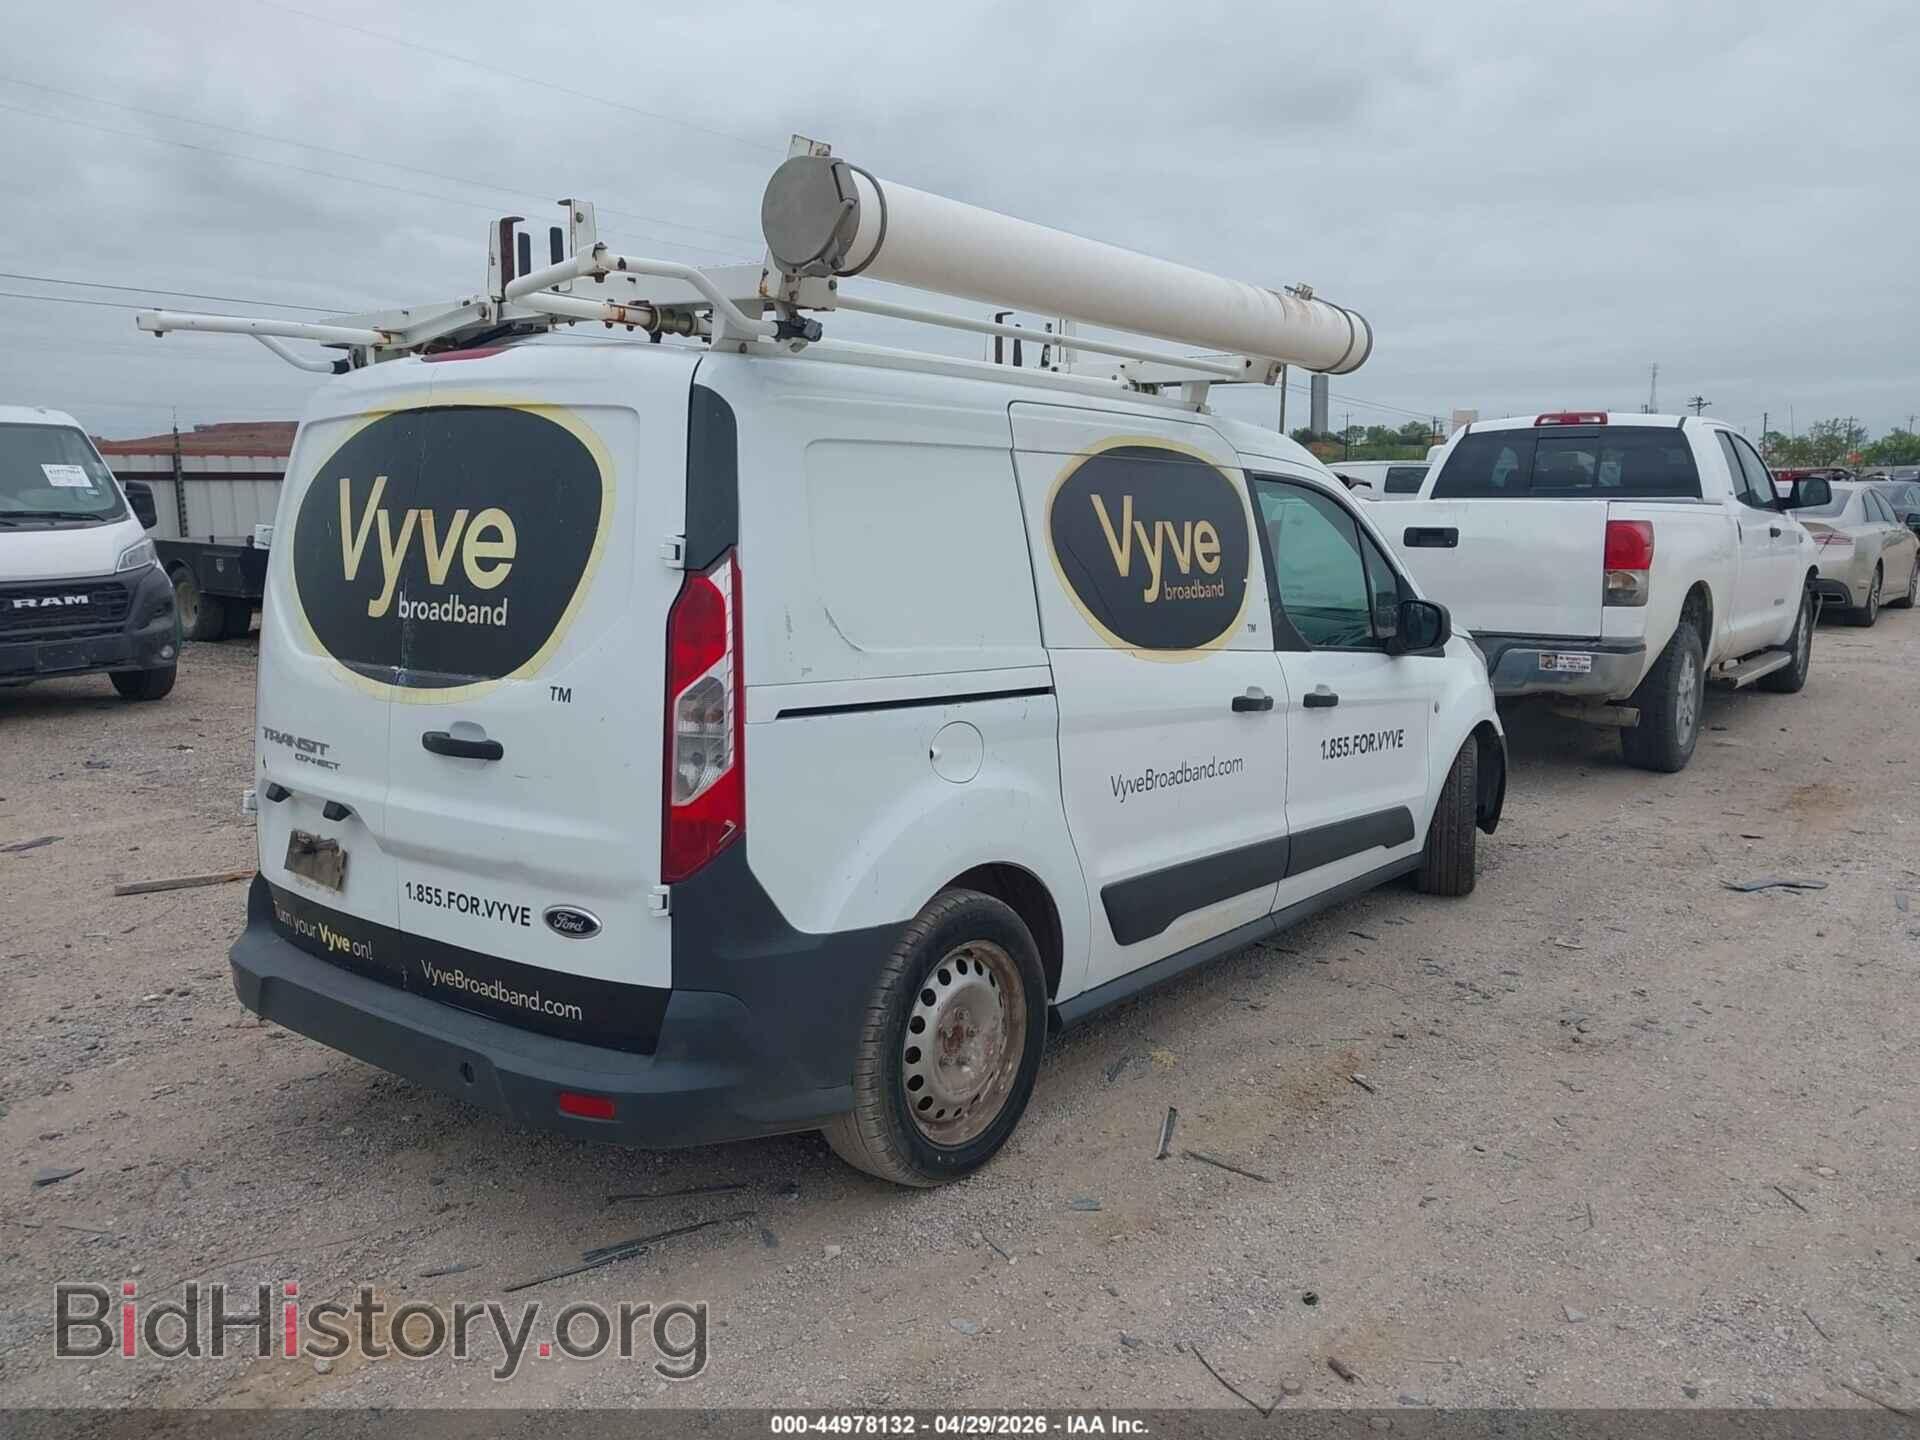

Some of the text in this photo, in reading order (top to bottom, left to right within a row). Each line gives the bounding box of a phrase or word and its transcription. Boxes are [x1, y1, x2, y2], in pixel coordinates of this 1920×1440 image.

[339, 476, 517, 617] Vyve
[1090, 494, 1221, 603] Vyve
[13, 595, 88, 608] RAM
[1164, 580, 1225, 601] broadband
[398, 592, 508, 626] broadband
[549, 686, 572, 703] TM
[262, 726, 330, 756] TRANSIT
[1320, 729, 1405, 760] 1.855.FOR.VYVE
[1111, 756, 1244, 803] VyveBroadband.com
[405, 881, 531, 927] 1.855.FOR.VYVE
[293, 916, 317, 938] your
[318, 922, 351, 952] Vyve
[352, 941, 373, 960] on!
[553, 912, 585, 932] Ford
[421, 959, 583, 1021] VyveBroadband.com
